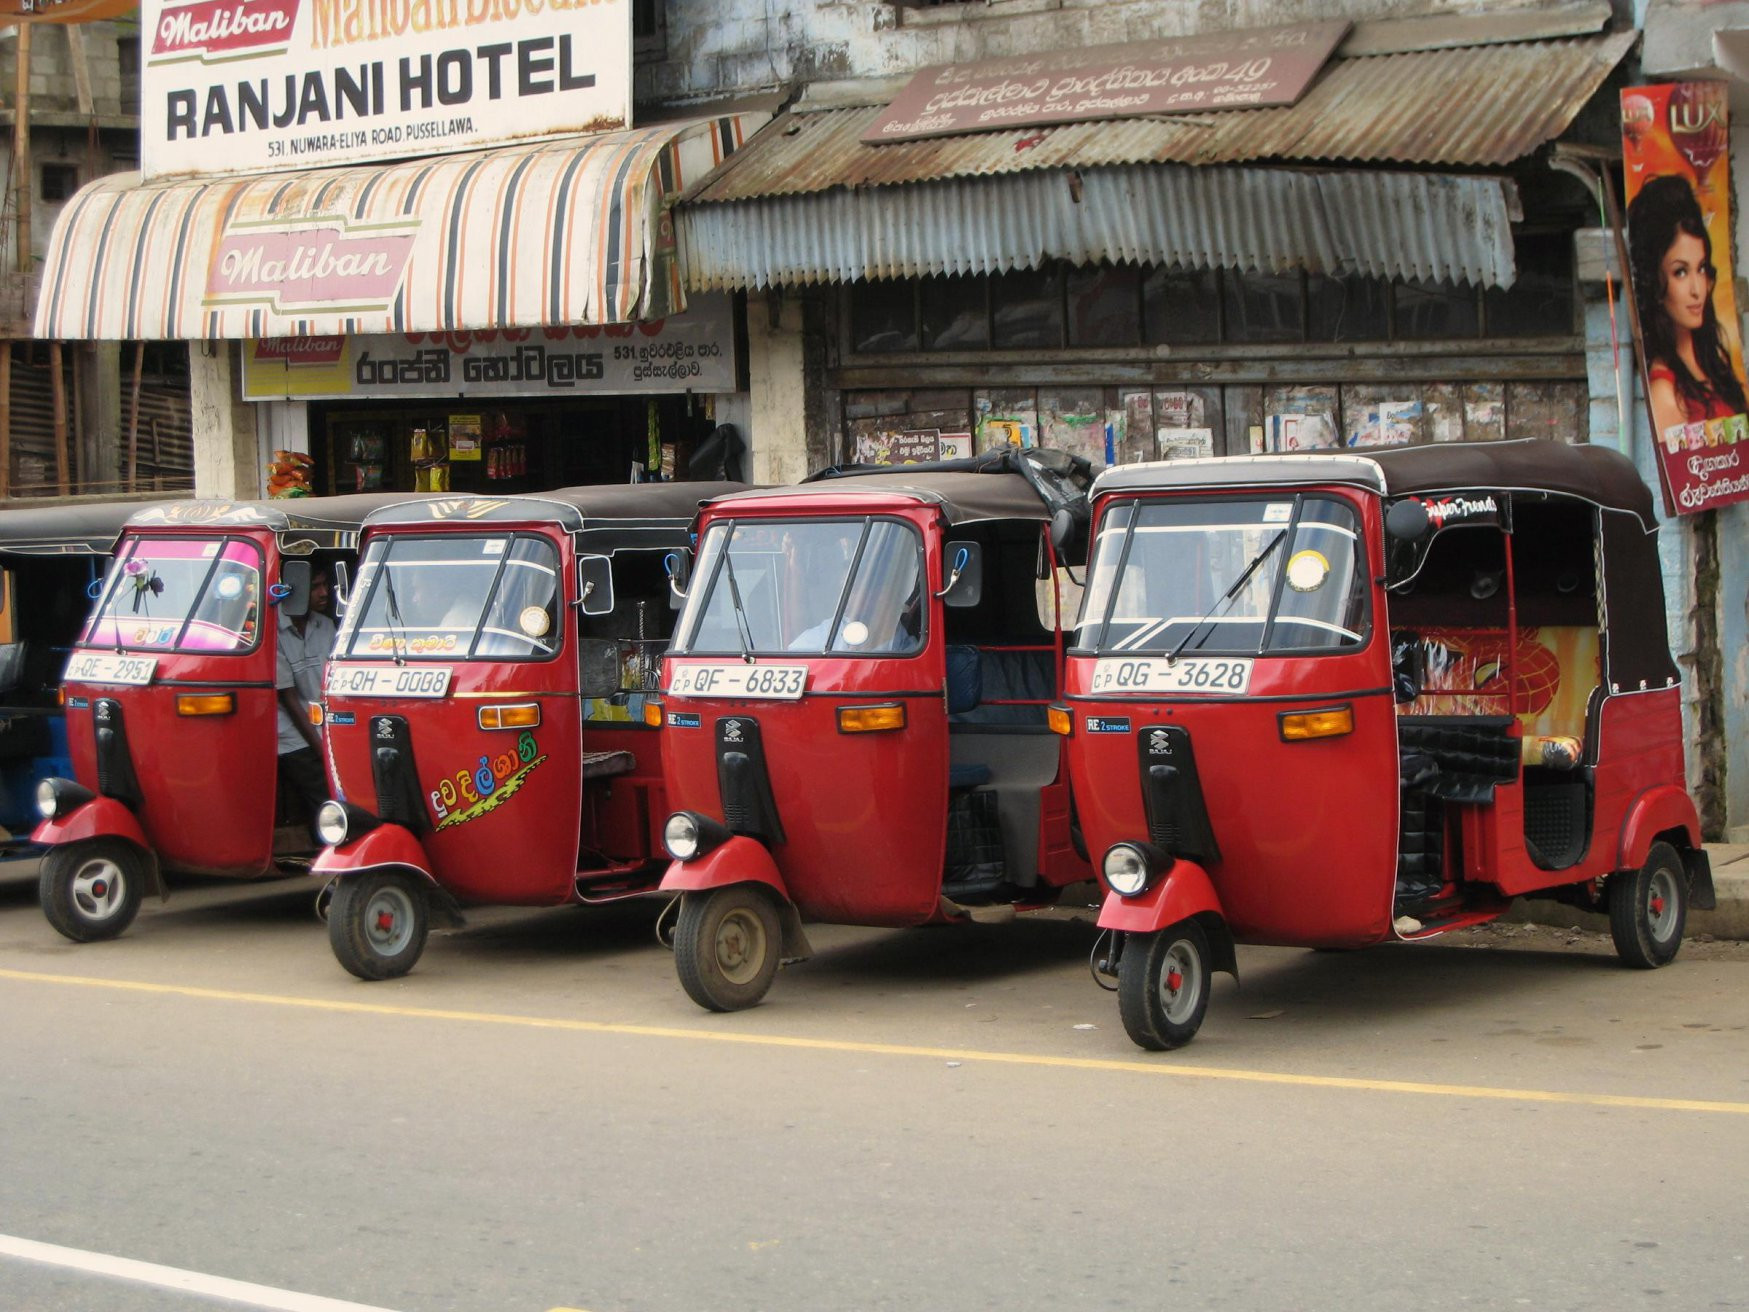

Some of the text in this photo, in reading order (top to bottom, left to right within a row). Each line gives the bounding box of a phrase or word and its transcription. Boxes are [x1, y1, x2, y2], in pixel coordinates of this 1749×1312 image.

[160, 5, 289, 48] Maliban
[166, 33, 597, 141] RANJANI HOTEL
[290, 131, 368, 155] NUWARA-ELIYA
[220, 242, 393, 286] Maliban
[261, 336, 341, 353] Maliban
[1087, 718, 1100, 731] RE
